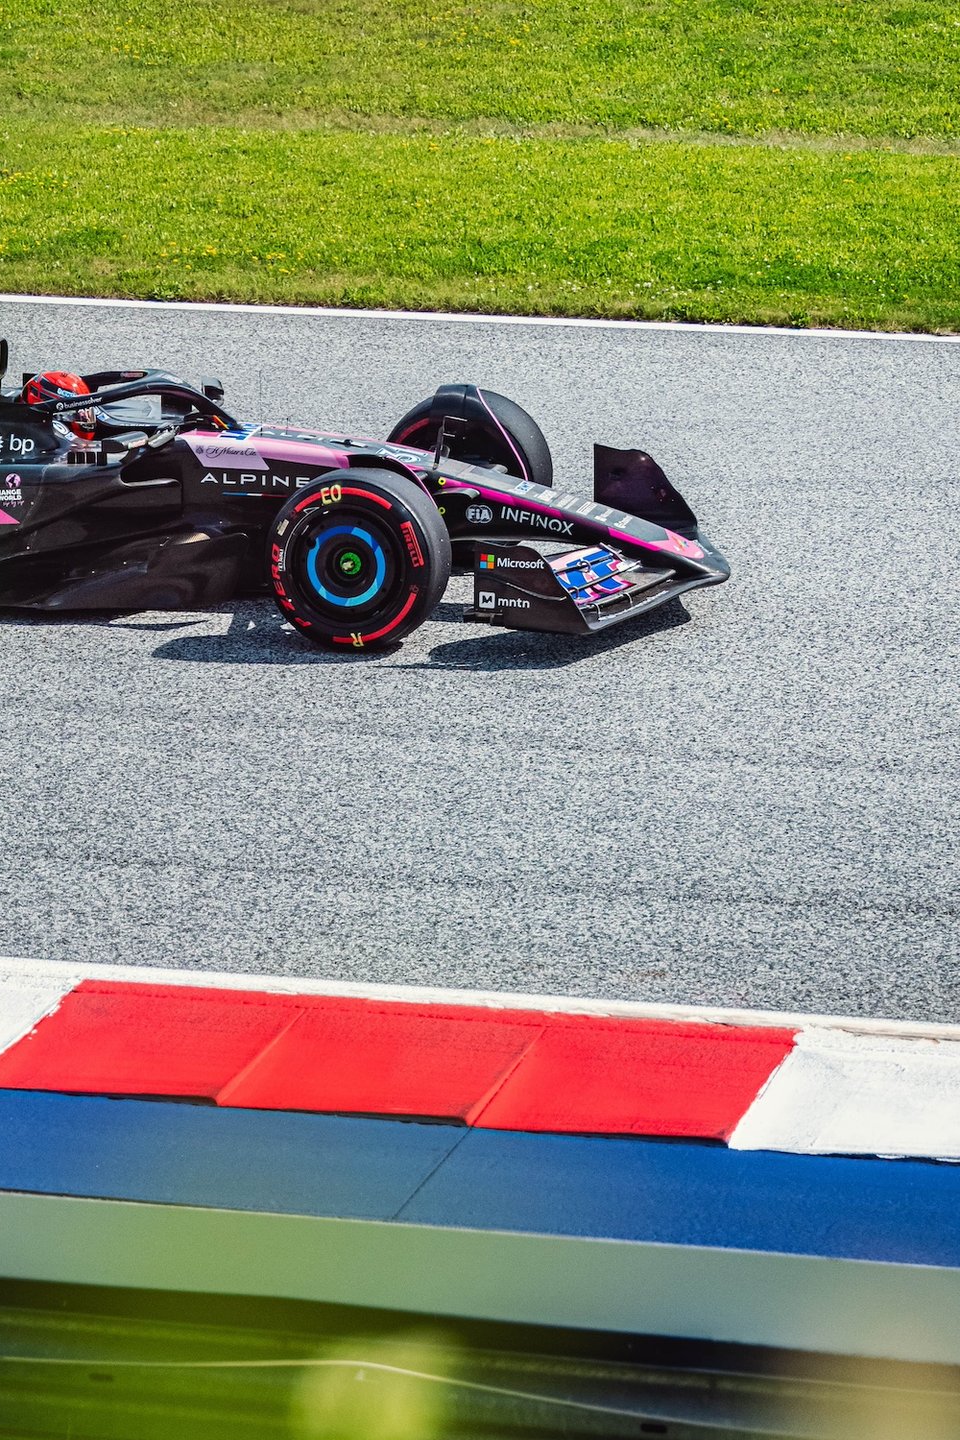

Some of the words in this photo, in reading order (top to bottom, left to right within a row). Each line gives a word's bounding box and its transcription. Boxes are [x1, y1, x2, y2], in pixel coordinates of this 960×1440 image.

[9, 434, 35, 455] bp
[200, 472, 311, 488] ALPINE
[501, 506, 574, 535] INFINOX
[400, 520, 425, 568] PIRELLI
[497, 558, 545, 569] Microsoft
[498, 598, 530, 609] mntn
